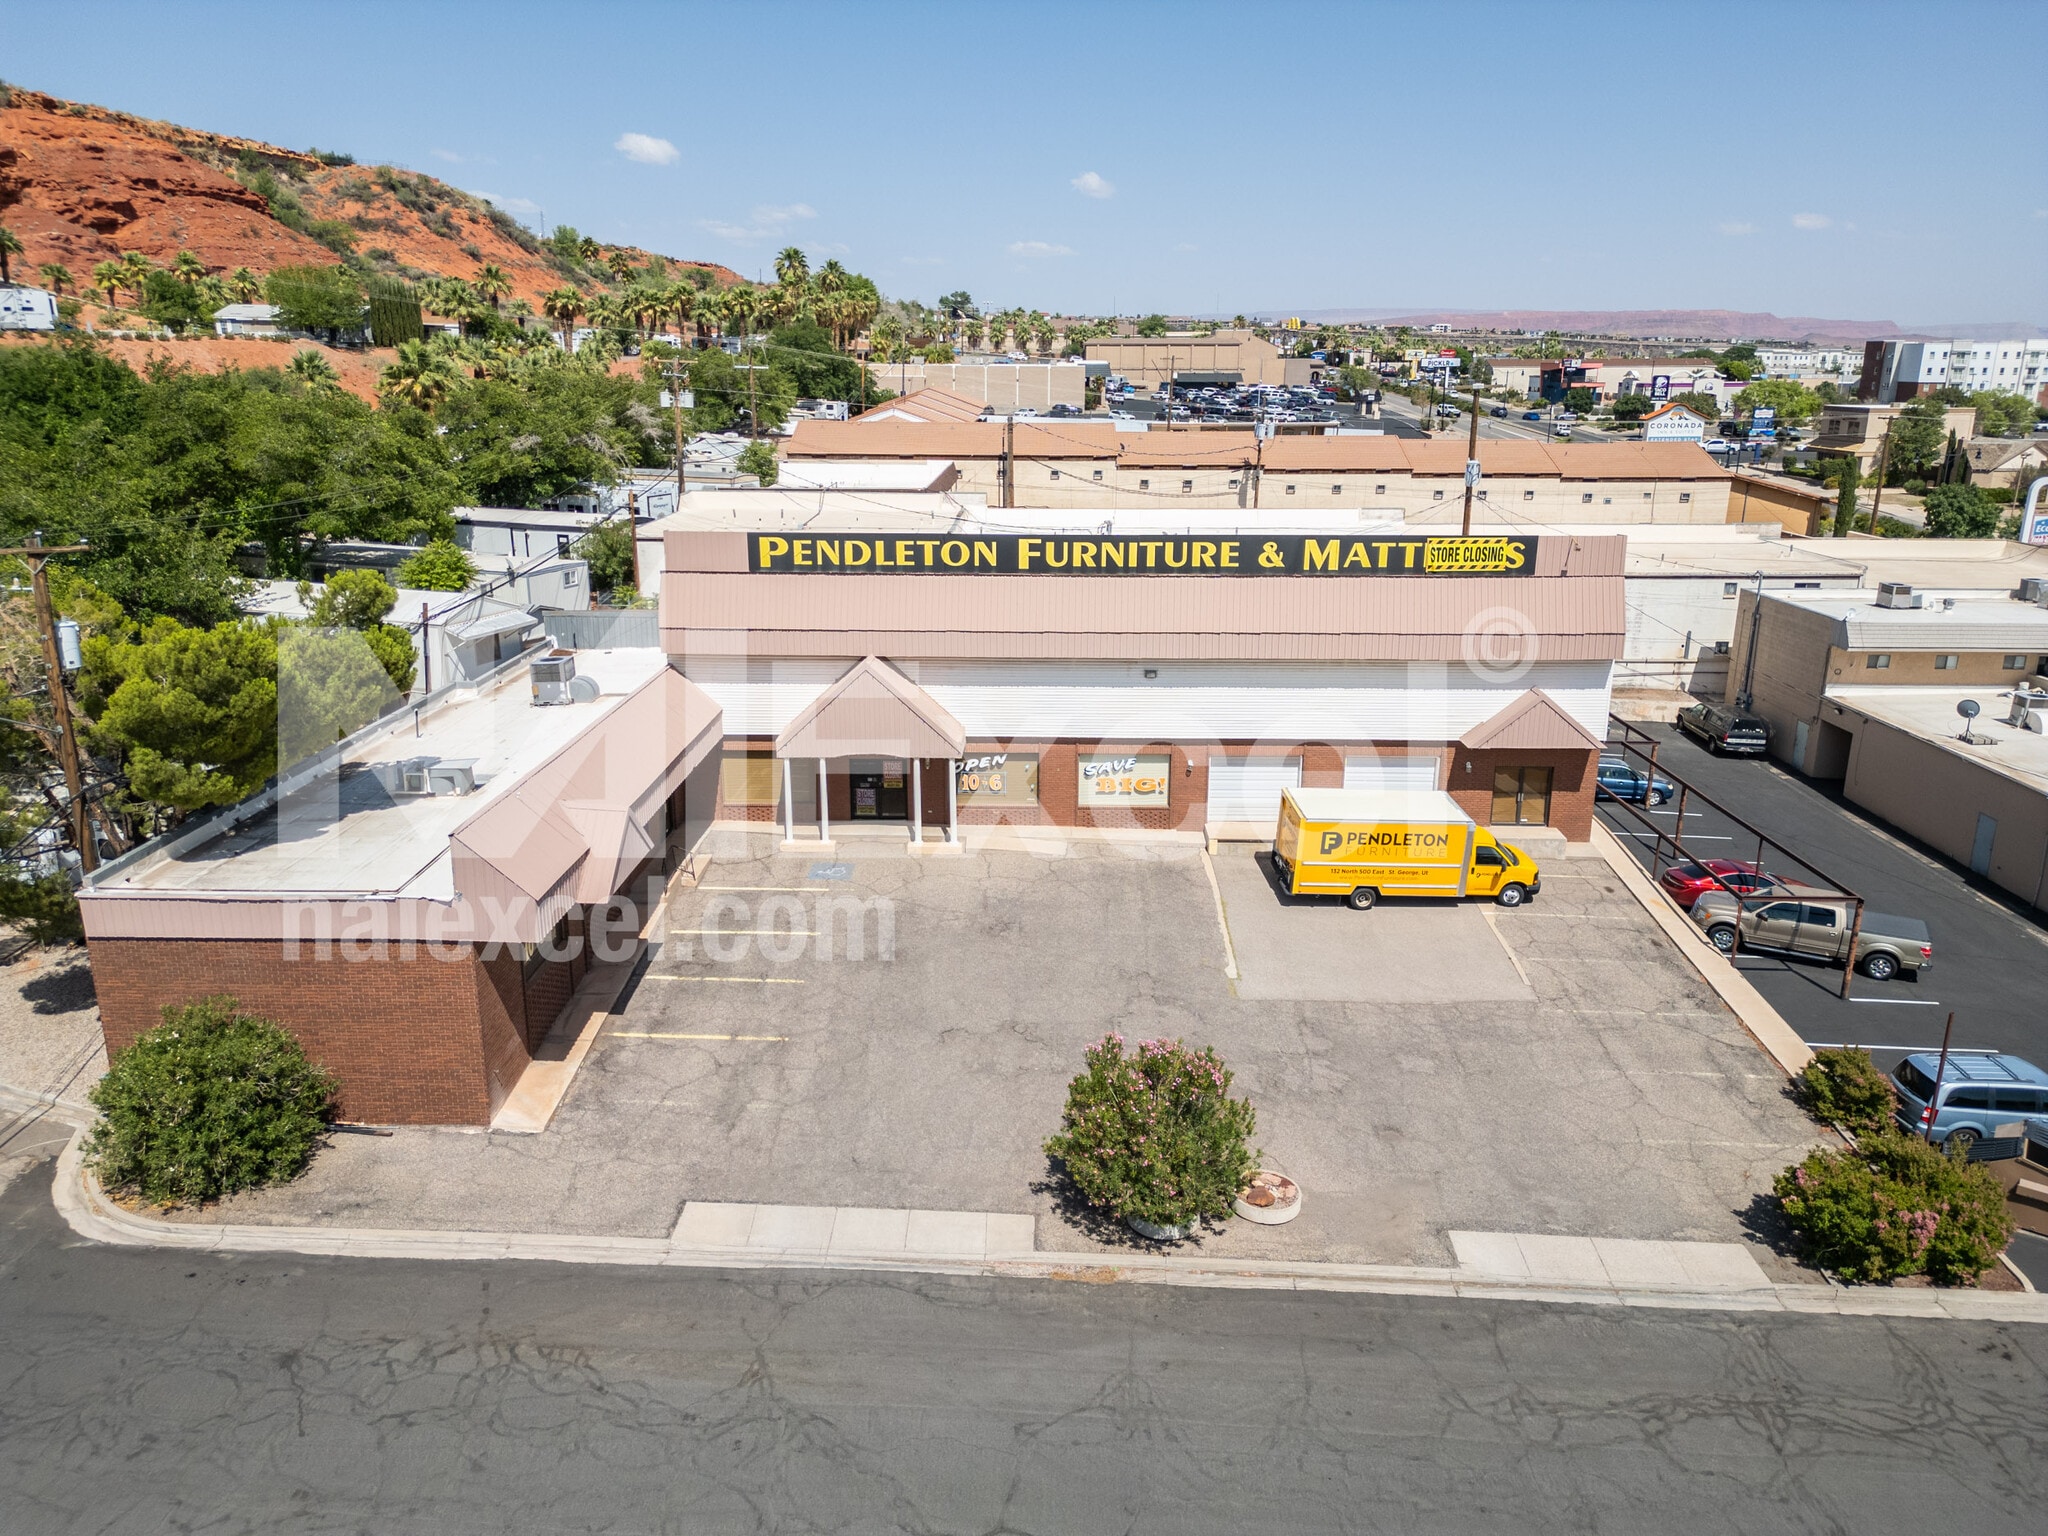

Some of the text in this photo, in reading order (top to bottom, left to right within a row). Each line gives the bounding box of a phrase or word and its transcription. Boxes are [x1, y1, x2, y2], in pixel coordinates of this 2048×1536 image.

[758, 536, 1526, 571] PENDLETON FURNITURE & MATTS
[1430, 546, 1505, 563] STORE CLOSING
[955, 753, 1008, 773] OPEN
[1083, 757, 1137, 776] SAVE
[961, 774, 980, 791] 10
[989, 774, 1002, 791] 6
[1096, 777, 1167, 793] BIG!
[1347, 832, 1449, 846] PENDLETON
[1345, 846, 1446, 858] FURNITURE
